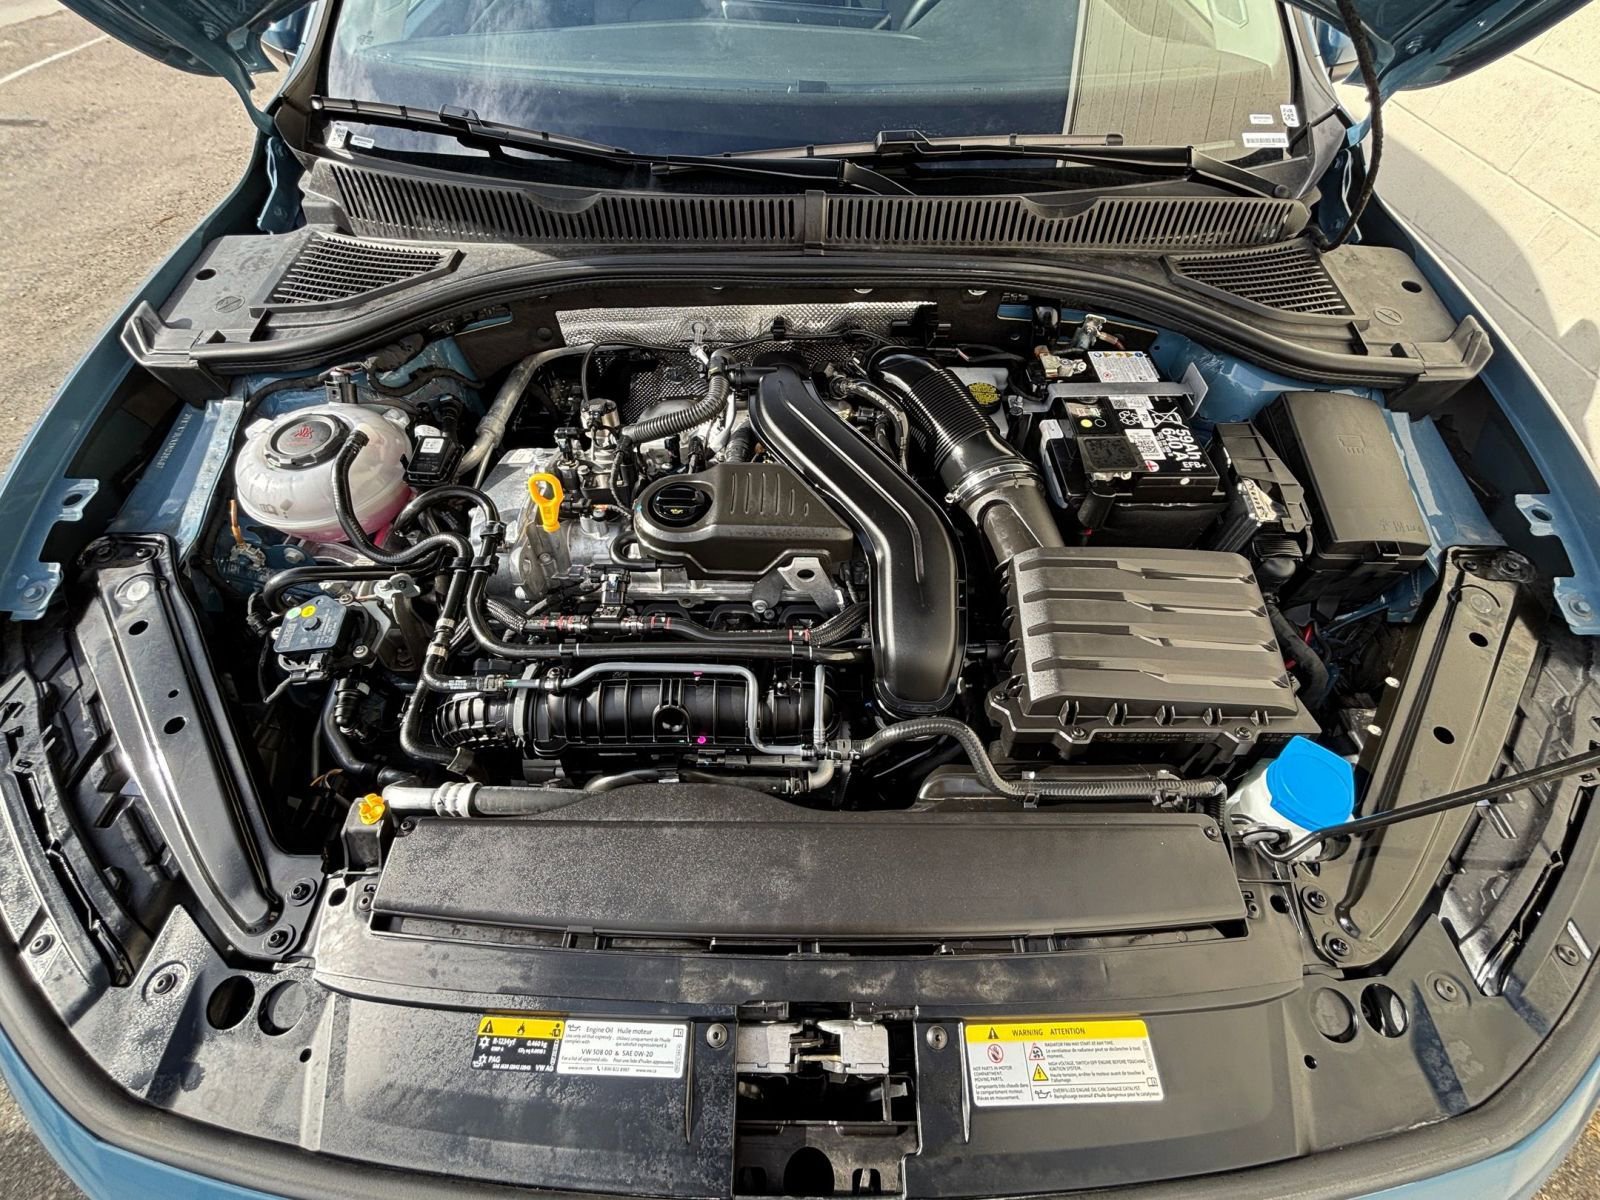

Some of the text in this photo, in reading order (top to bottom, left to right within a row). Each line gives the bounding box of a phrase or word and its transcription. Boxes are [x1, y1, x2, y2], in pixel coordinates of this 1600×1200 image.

[1161, 427, 1184, 450] 640
[1174, 428, 1202, 460] 59Ah
[1172, 451, 1188, 462] A
[1182, 460, 1208, 468] EFB+
[586, 1026, 605, 1034] Engine
[1012, 1027, 1086, 1036] WARNING ATTENTION
